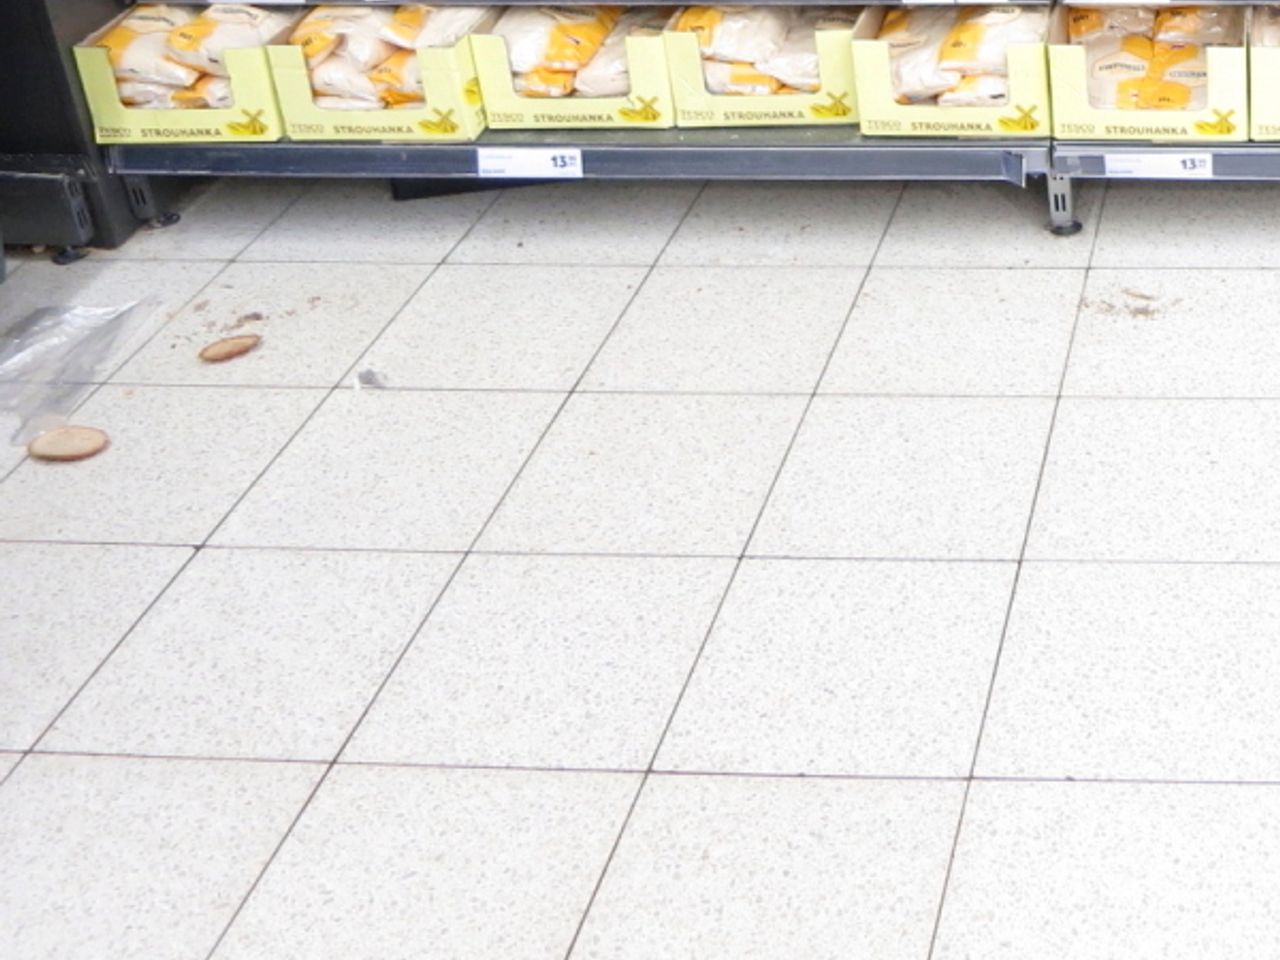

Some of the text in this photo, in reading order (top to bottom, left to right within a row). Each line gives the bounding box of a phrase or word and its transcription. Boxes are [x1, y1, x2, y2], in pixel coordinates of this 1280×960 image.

[533, 114, 613, 123] STROUHANKA
[723, 111, 805, 121] STROUHANKA
[333, 125, 414, 135] STROUHANKA
[911, 122, 993, 132] STROUHANKA
[1104, 126, 1188, 136] STROUHANKA
[140, 127, 222, 138] STROUHANKA
[551, 156, 567, 168] 13
[1181, 158, 1196, 170] 13
